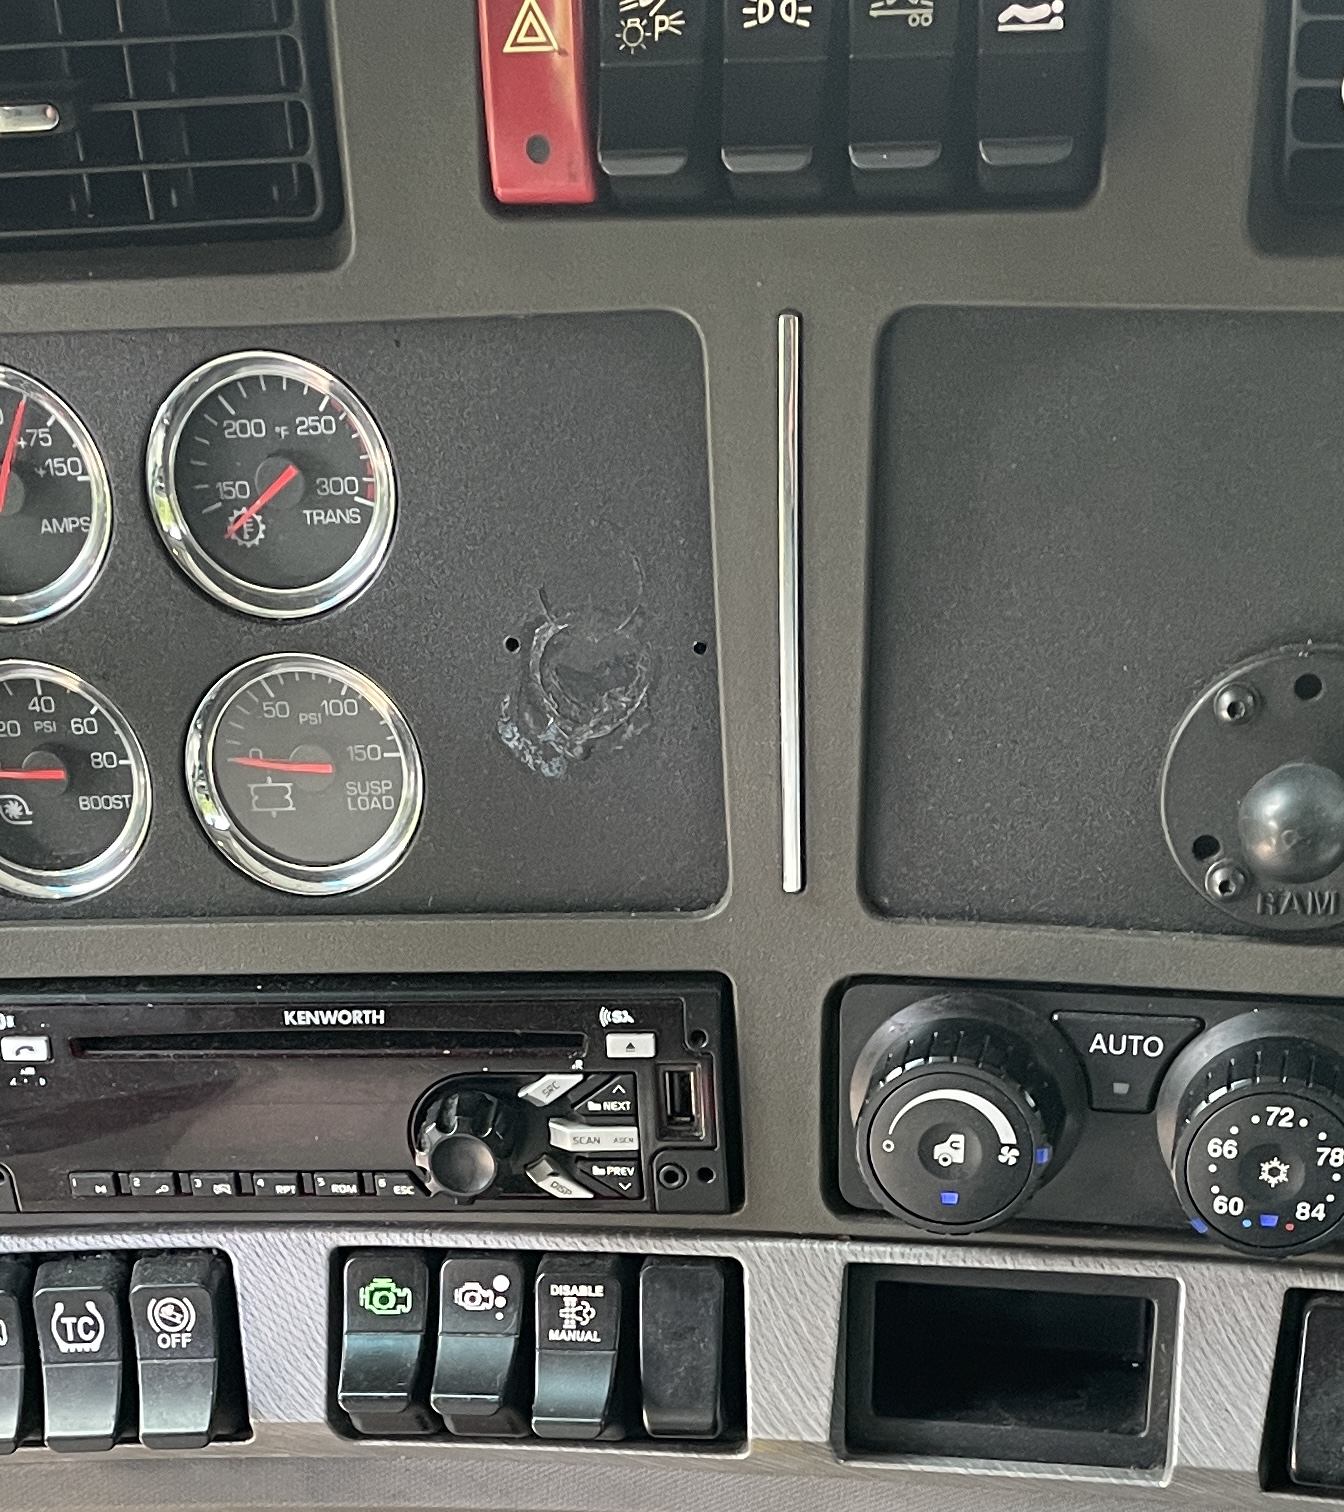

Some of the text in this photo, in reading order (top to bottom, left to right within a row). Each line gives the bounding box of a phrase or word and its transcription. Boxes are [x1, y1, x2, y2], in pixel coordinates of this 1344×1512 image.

[224, 418, 265, 438] 200
[296, 416, 337, 436] 250
[215, 480, 250, 500] 150
[316, 476, 359, 496] 300
[40, 517, 91, 535] AMPS
[303, 508, 361, 526] TRANS
[28, 696, 55, 714] 40
[263, 701, 290, 718] 50
[321, 698, 358, 717] 100
[34, 721, 57, 734] PSI
[70, 718, 98, 735] 60
[298, 712, 323, 726] PSI
[90, 752, 118, 769] 80
[347, 744, 383, 762] 150
[345, 780, 393, 796] SUSP
[79, 794, 132, 812] BOOST
[346, 795, 395, 811] LOAD
[1257, 891, 1340, 916] RAM
[283, 1009, 385, 1026] KENWORTH
[1088, 1031, 1164, 1058] AUTO
[541, 1080, 561, 1098] SRC
[603, 1101, 631, 1111] NEXT
[1264, 1105, 1295, 1129] 72
[573, 1136, 601, 1145] SCAN
[1207, 1136, 1239, 1160] 66
[607, 1166, 635, 1177] PREV
[392, 1185, 415, 1195] ESC
[1212, 1195, 1245, 1217] 60
[1294, 1201, 1326, 1223] 84
[549, 1283, 605, 1298] DISABLE
[60, 1319, 97, 1342] TC
[547, 1329, 602, 1344] MANUAL
[156, 1332, 193, 1350] OFF
